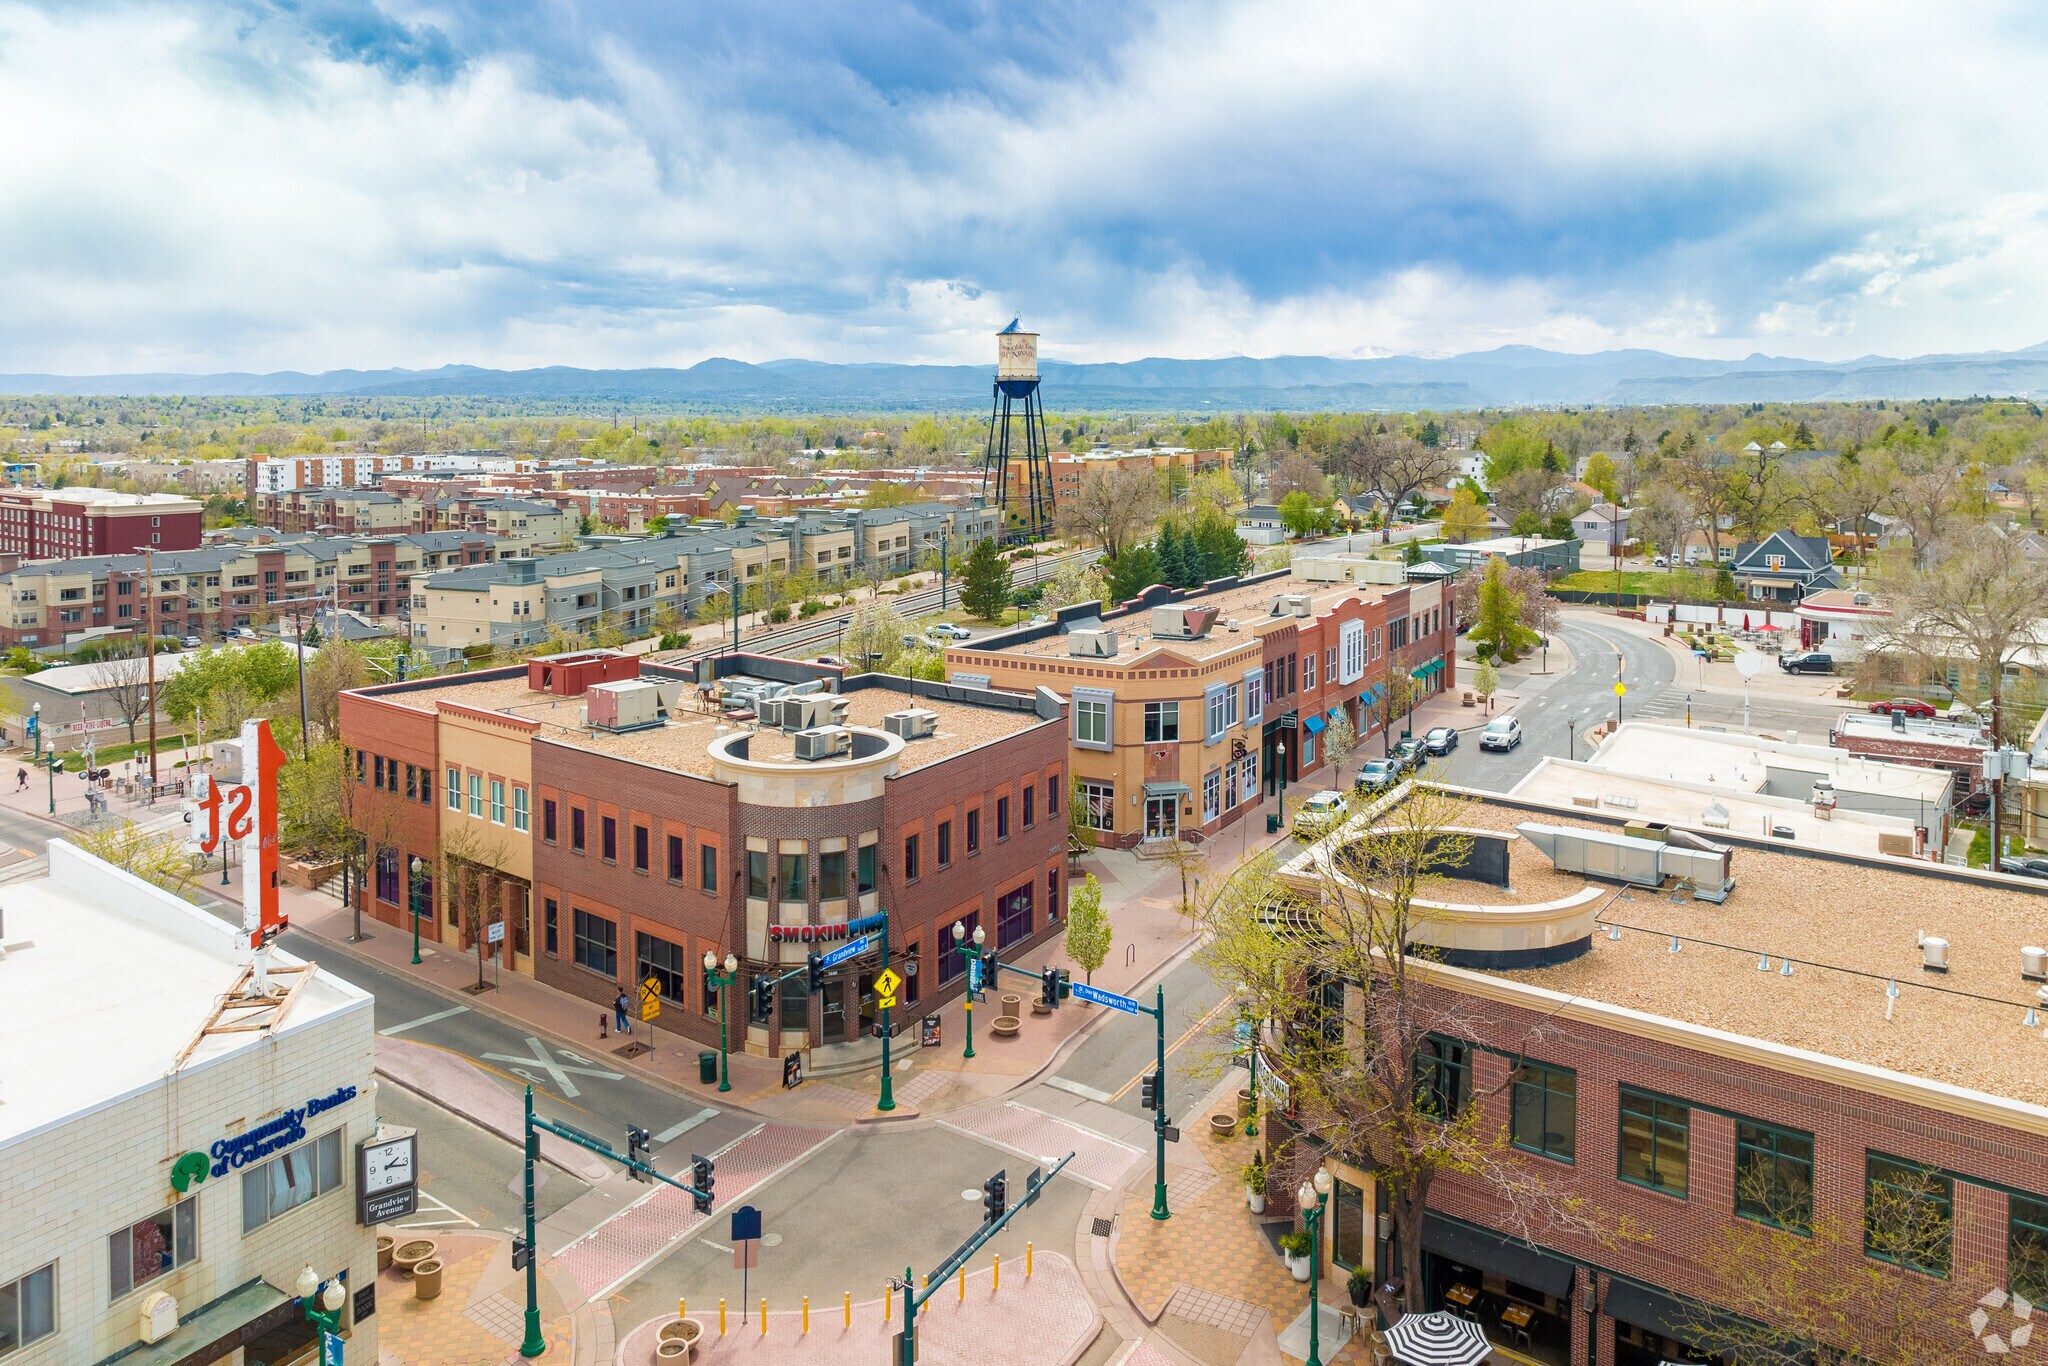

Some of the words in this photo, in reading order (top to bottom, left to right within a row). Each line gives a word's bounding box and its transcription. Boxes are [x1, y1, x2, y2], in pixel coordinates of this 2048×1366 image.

[770, 923, 847, 943] SMOKIN
[832, 945, 856, 962] Grandview
[1092, 990, 1127, 1009] Wadsworth
[211, 1107, 306, 1160] Community
[306, 1085, 357, 1118] Banks
[211, 1153, 230, 1178] of
[230, 1125, 306, 1169] Colorado
[384, 1147, 393, 1157] 12
[369, 1166, 377, 1175] 9
[402, 1157, 409, 1167] 3
[386, 1175, 393, 1184] 6
[369, 1195, 411, 1212] Grandview
[376, 1204, 404, 1218] Avenue
